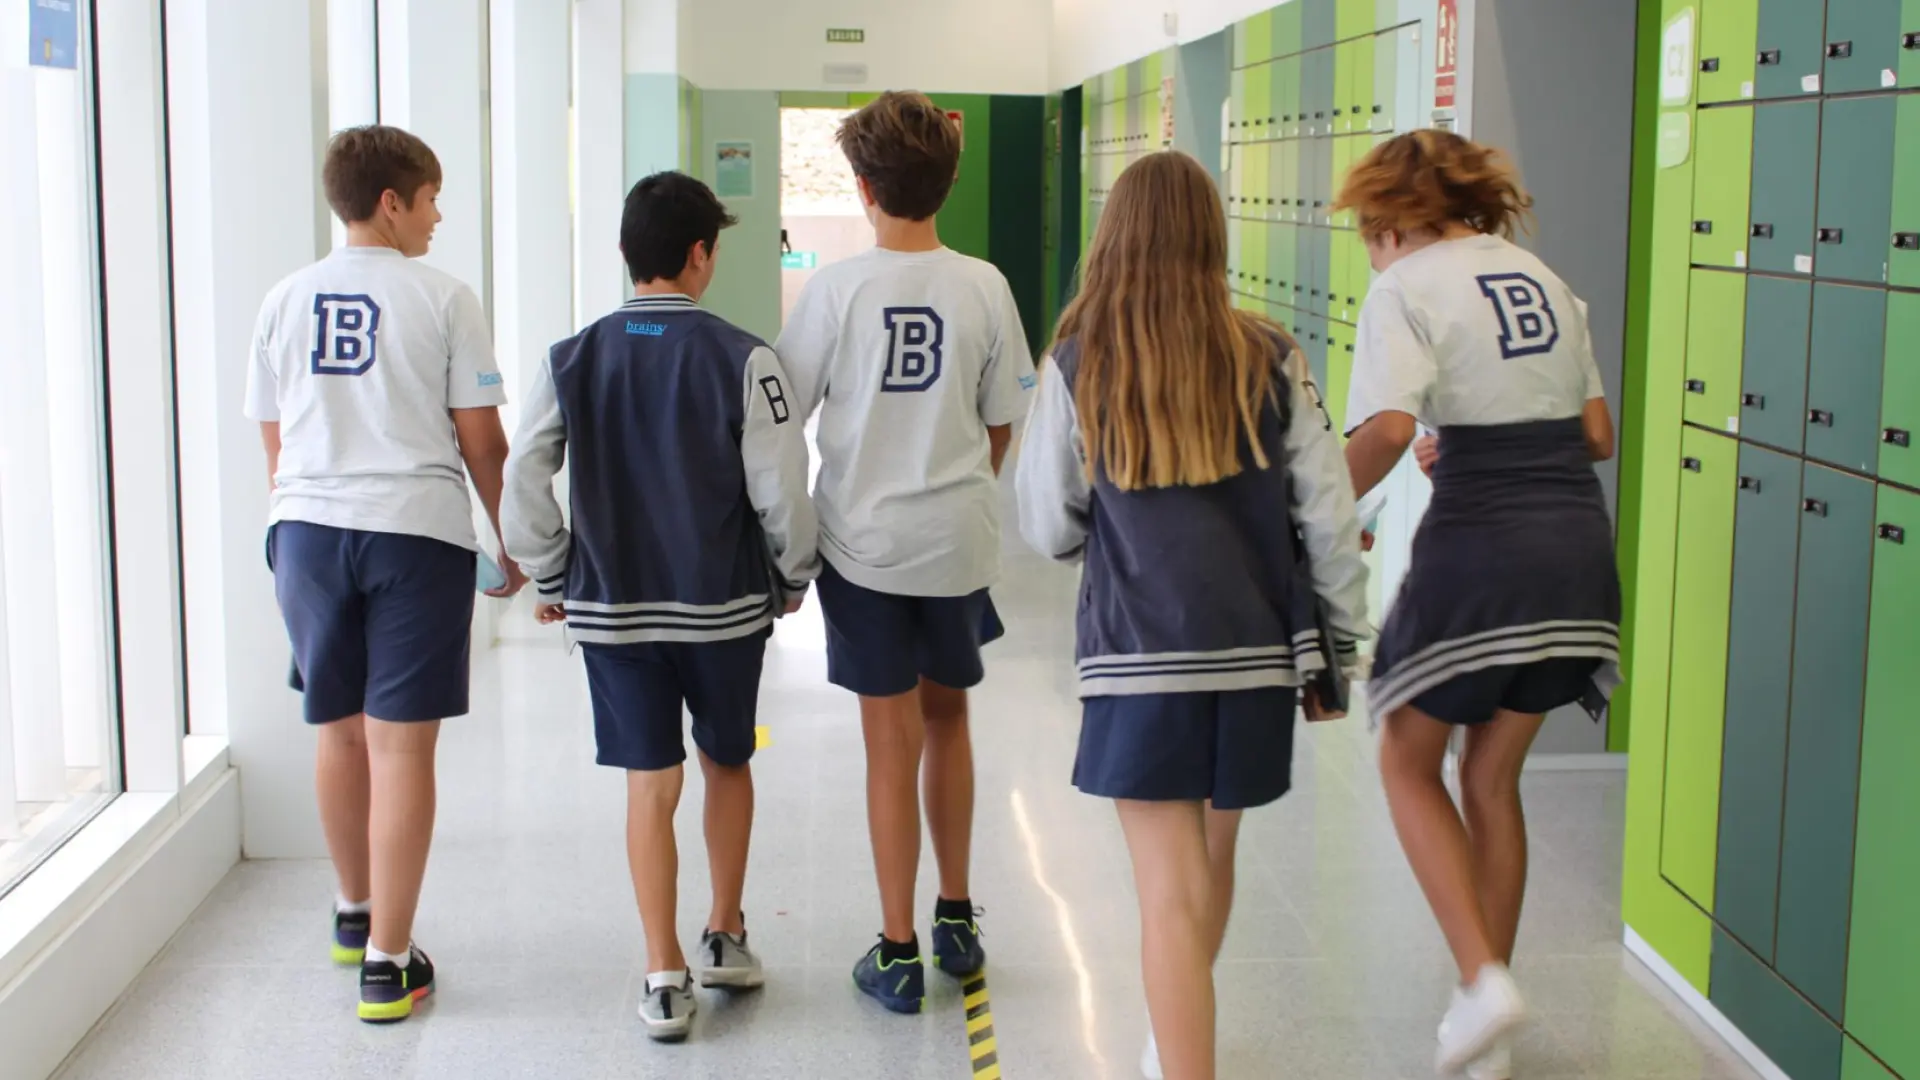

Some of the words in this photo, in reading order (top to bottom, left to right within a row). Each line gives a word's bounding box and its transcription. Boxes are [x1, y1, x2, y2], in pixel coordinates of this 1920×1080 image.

[311, 292, 381, 376] B
[880, 306, 944, 392] B
[1475, 272, 1560, 360] B
[759, 375, 789, 424] B
